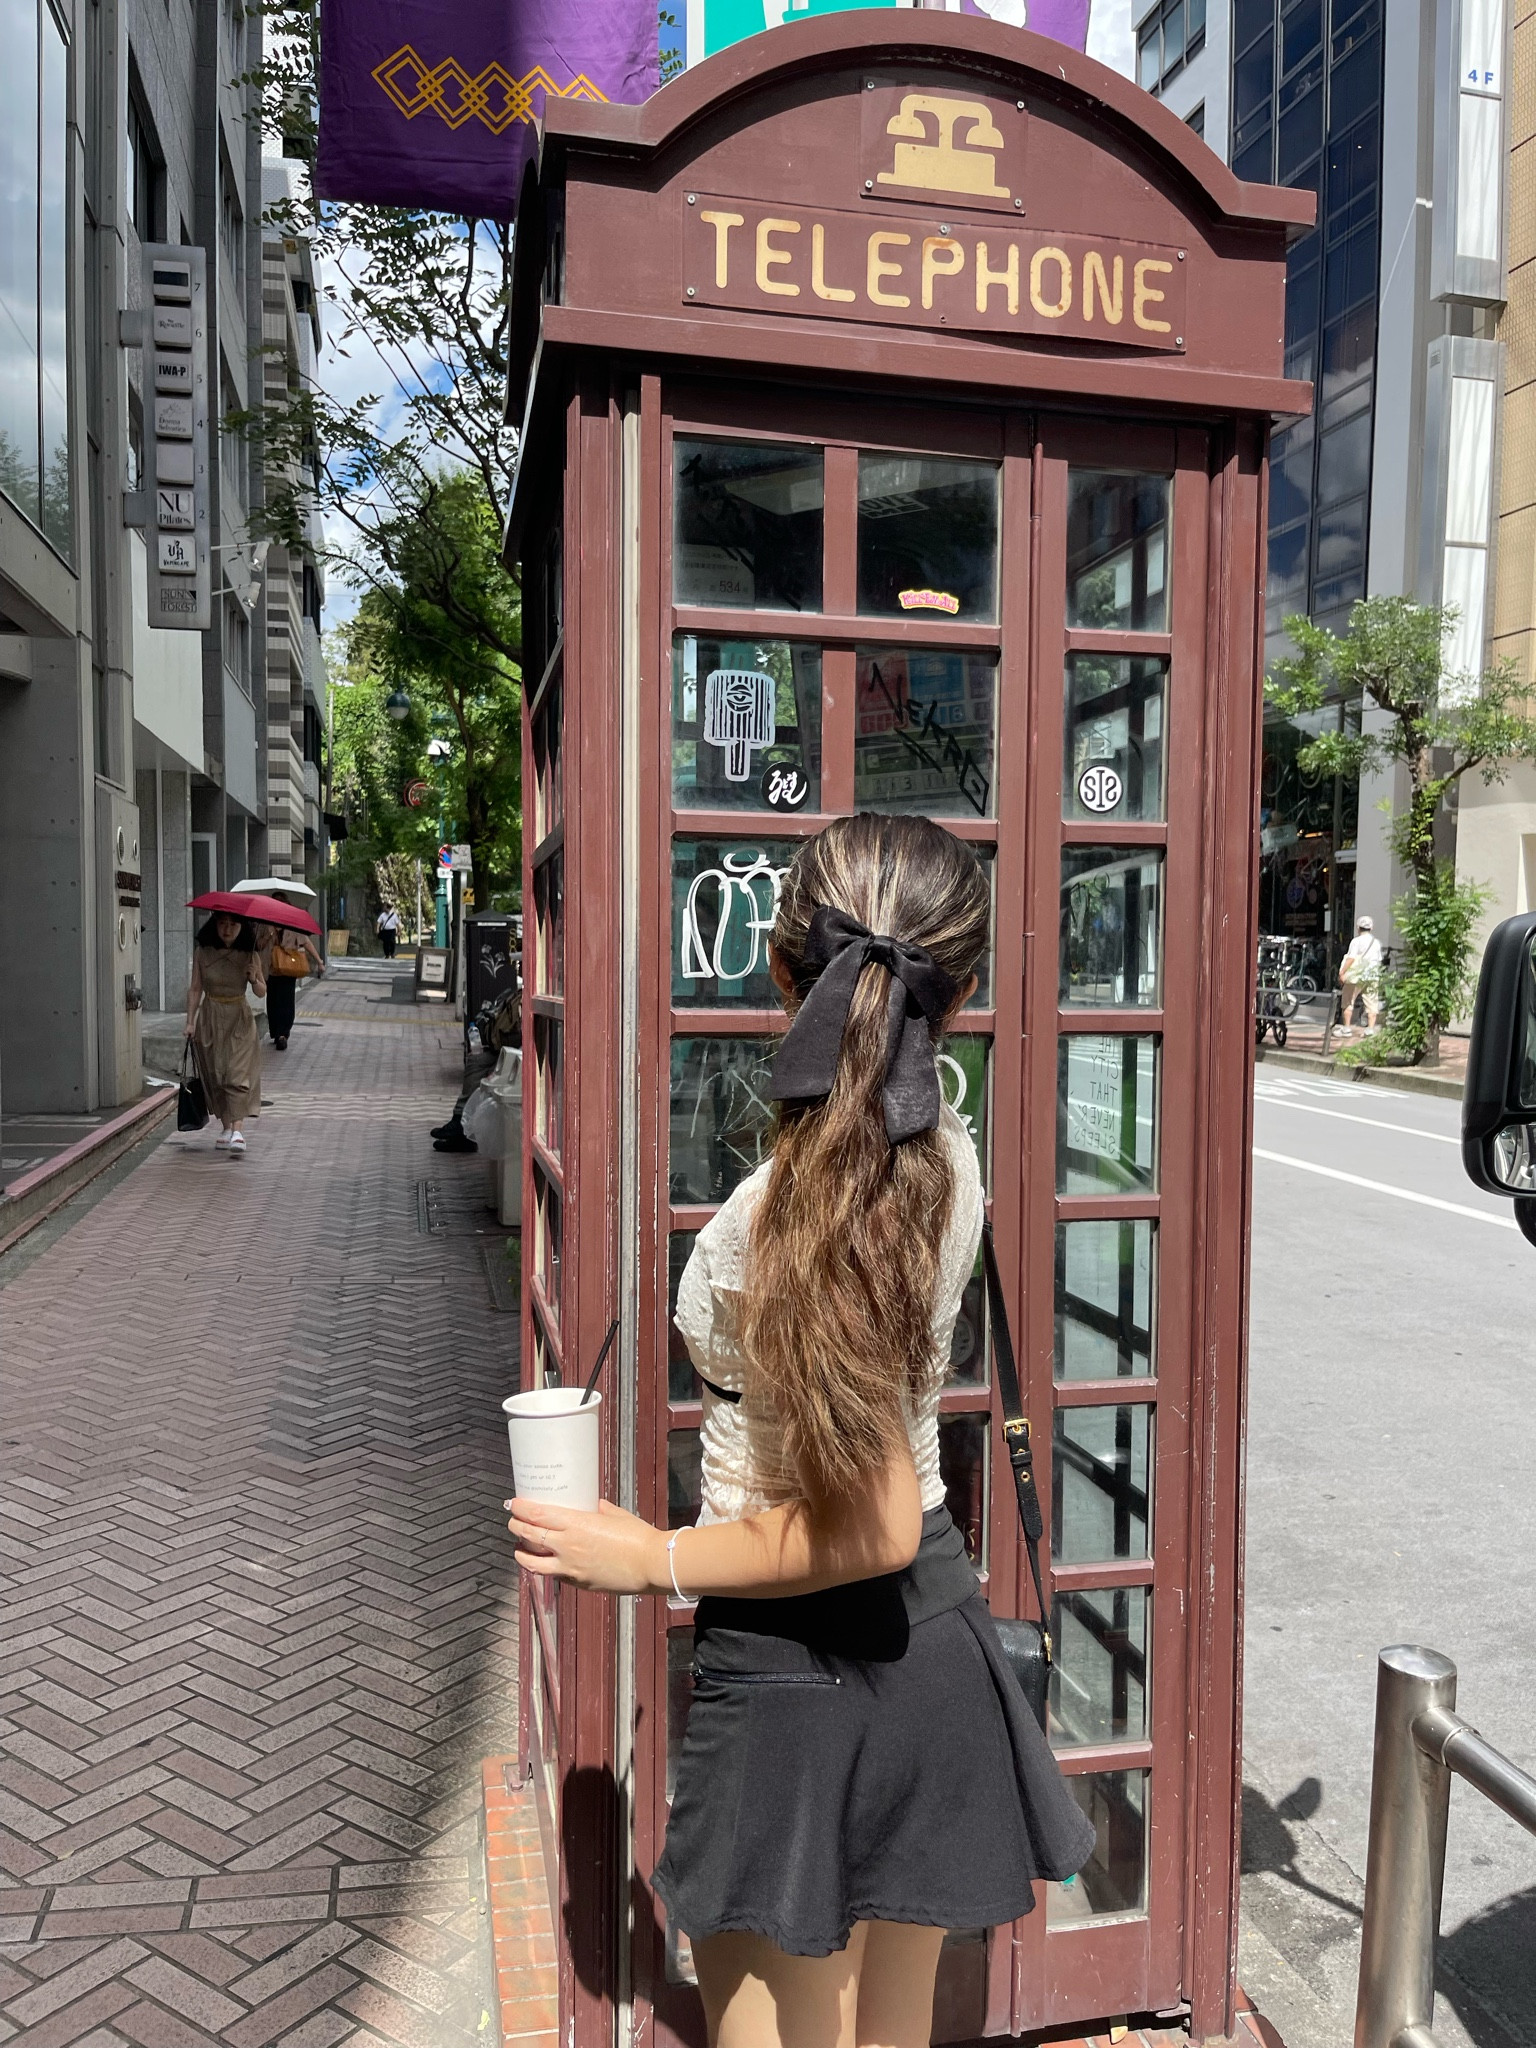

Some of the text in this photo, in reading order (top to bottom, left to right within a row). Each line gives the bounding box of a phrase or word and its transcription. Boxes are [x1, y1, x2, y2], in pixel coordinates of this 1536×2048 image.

[700, 210, 1173, 333] TELEPHONE
[194, 282, 201, 292] 7
[195, 328, 202, 338] 6
[158, 364, 187, 377] IWA-P
[196, 374, 203, 384] 5
[196, 419, 203, 430] 4
[197, 464, 204, 474] 3
[159, 492, 191, 513] NU
[159, 513, 191, 524] Pilates
[198, 509, 205, 519] 2
[719, 581, 741, 594] 534
[161, 601, 197, 613] FOREST
